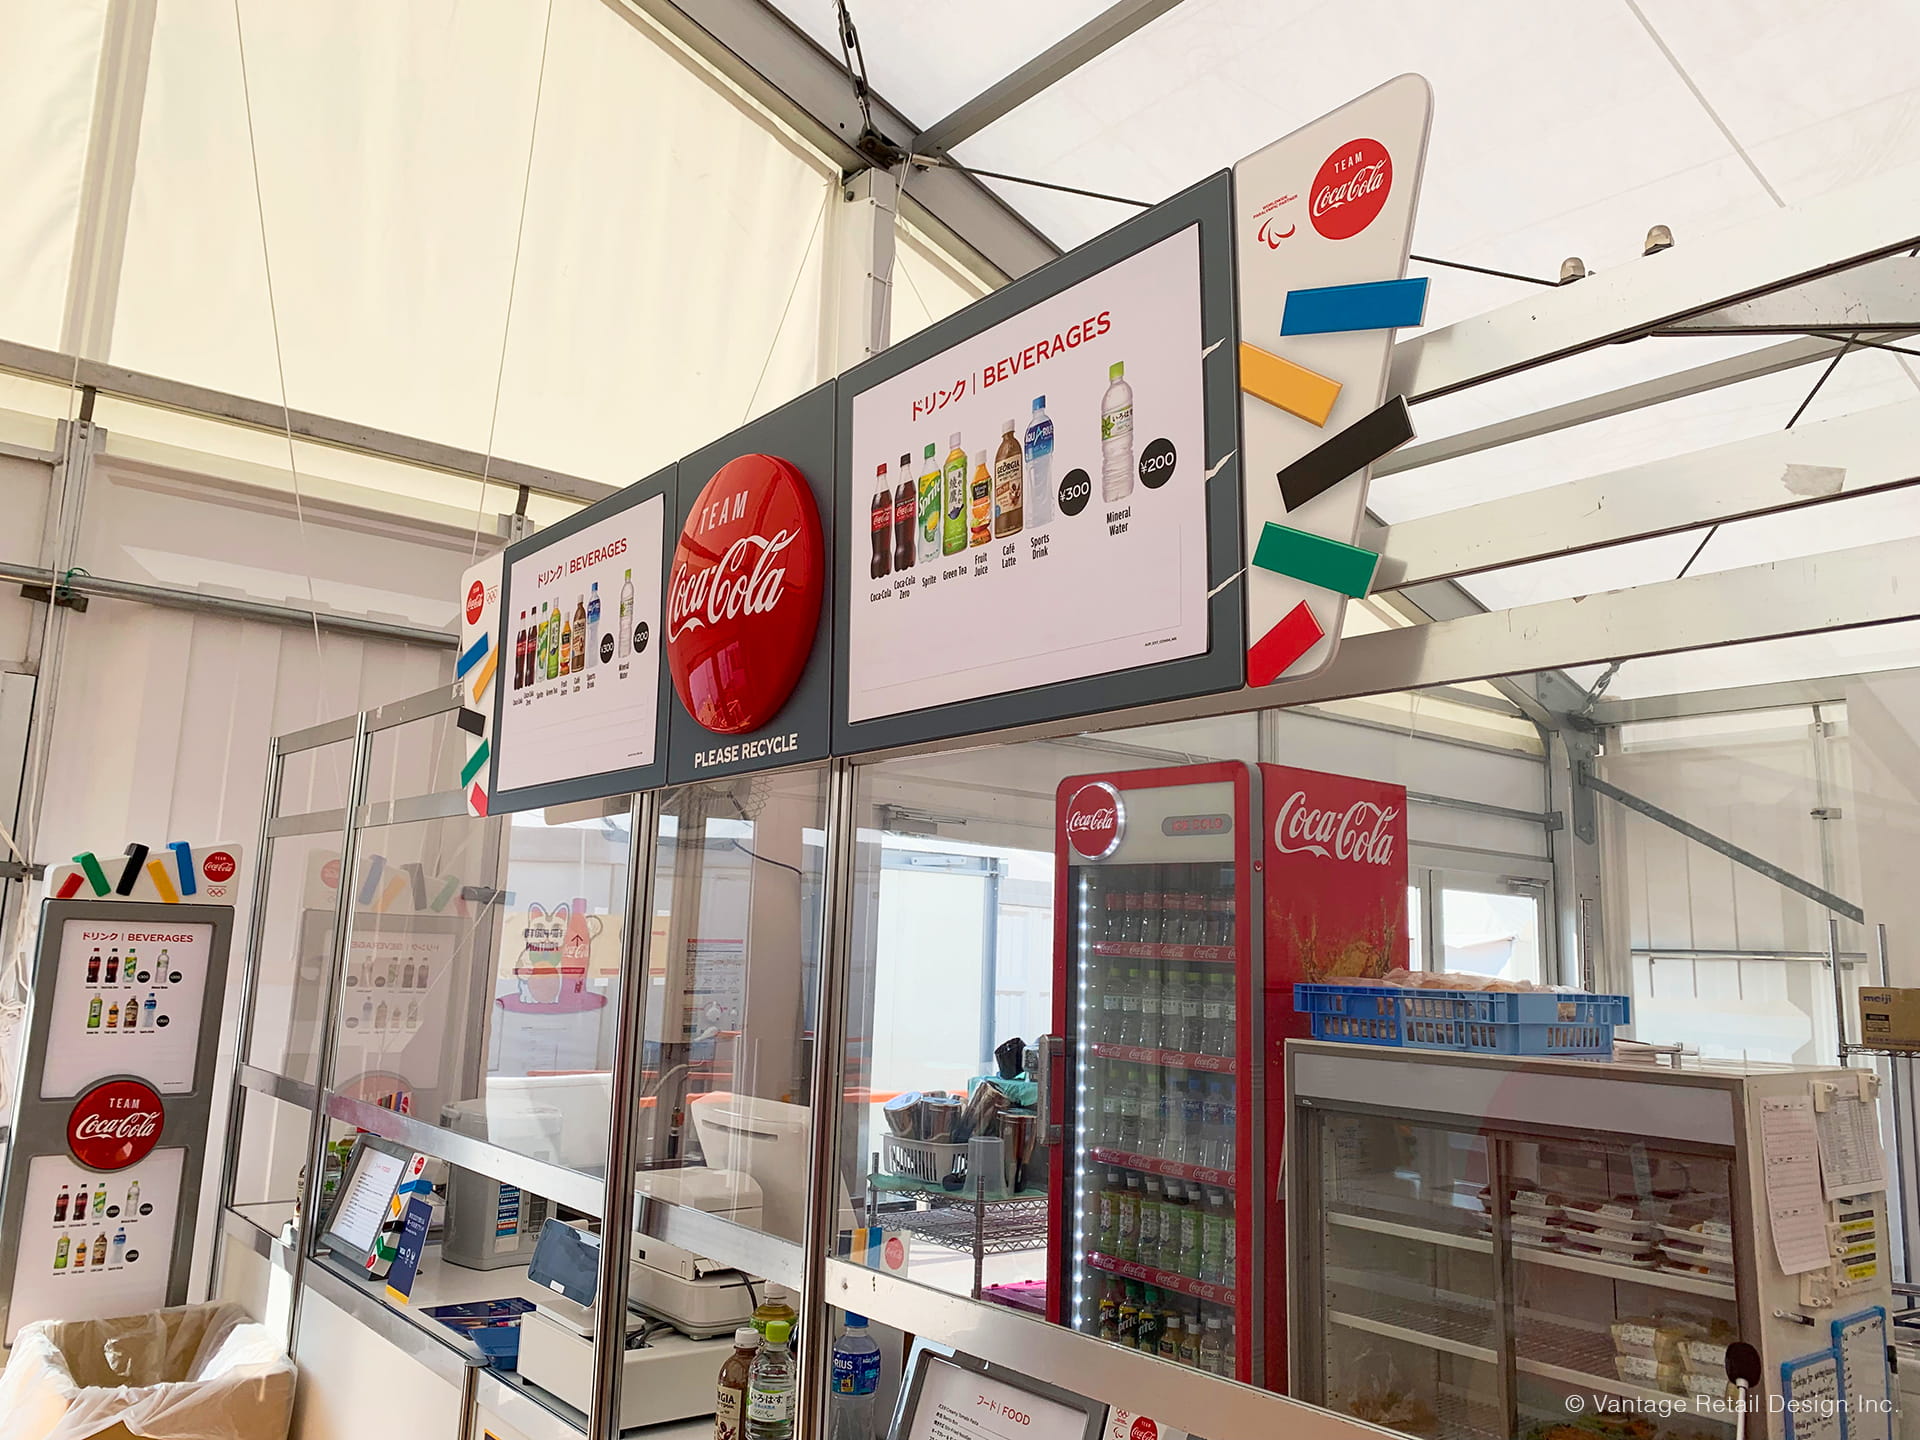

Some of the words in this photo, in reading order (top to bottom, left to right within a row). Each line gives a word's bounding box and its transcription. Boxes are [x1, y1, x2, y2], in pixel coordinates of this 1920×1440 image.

[1334, 151, 1363, 174] TEAM
[1313, 157, 1387, 217] Coca-Cola
[911, 379, 967, 422] ドリンク
[983, 311, 1112, 389] BEVERAGES
[1140, 452, 1175, 475] ¥200
[1060, 481, 1090, 502] ¥300
[700, 490, 749, 535] TEAM
[1106, 506, 1132, 524] Mineral
[1109, 522, 1129, 536] Water
[1030, 534, 1050, 548] Sports
[1002, 543, 1015, 556] Café
[1032, 546, 1049, 560] Drink
[537, 565, 563, 588] ドリンク
[569, 537, 627, 574] BEVERAGES
[974, 552, 988, 565] Fruit
[1001, 556, 1017, 568] Latte
[942, 568, 958, 581] Green
[958, 566, 967, 576] Tea
[974, 565, 988, 577] Juice
[667, 527, 801, 644] Coca-Cola
[894, 575, 916, 590] Coca-Cola
[922, 575, 937, 588] Sprite
[870, 588, 892, 602] Coca-Cola
[899, 589, 910, 600] Zero
[694, 740, 739, 769] PLEASE
[741, 733, 798, 760] RECYCLE
[1070, 808, 1115, 832] Coca-Cola
[1191, 818, 1223, 830] COLD
[1274, 791, 1400, 866] Coca-Cola
[204, 861, 234, 872] Coca-Cola
[82, 932, 118, 941] ドリンク
[127, 933, 194, 943] BEVERAGES
[1863, 994, 1891, 1004] meiji
[109, 1098, 140, 1109] TEAM
[76, 1112, 161, 1140] Coca-Cola
[976, 1395, 997, 1411] フード
[1002, 1406, 1031, 1426] FOOD
